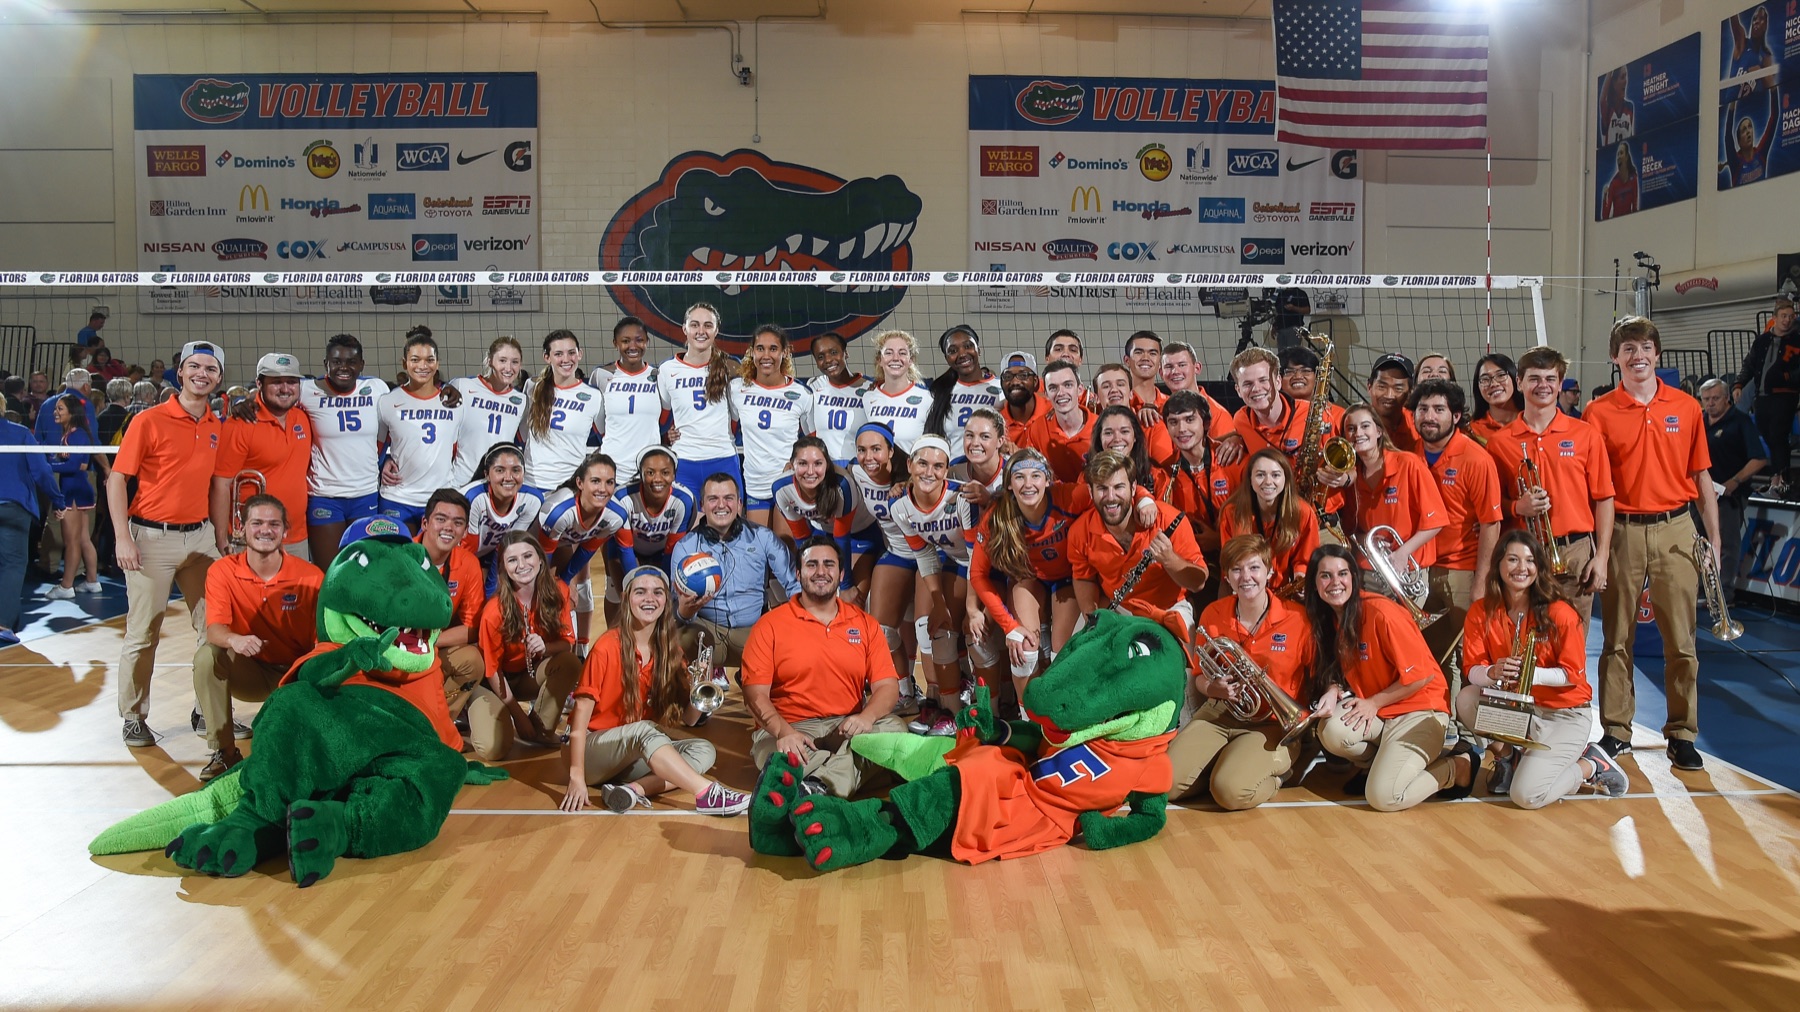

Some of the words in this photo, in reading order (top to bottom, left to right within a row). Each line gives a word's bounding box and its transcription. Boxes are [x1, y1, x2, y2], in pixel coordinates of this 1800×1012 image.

[1643, 72, 1667, 87] HEATHER
[1643, 79, 1669, 96] WRIGHT
[259, 82, 489, 118] VOLLEYBALL
[1092, 86, 1276, 123] VOLLEYBA
[153, 150, 200, 161] WELLS
[403, 149, 443, 164] WCA
[986, 151, 1033, 161] WELLS
[155, 161, 200, 172] FARGO
[234, 156, 295, 168] Domino's
[987, 161, 1033, 172] FARGO
[1067, 158, 1128, 170] Domino's
[1234, 155, 1273, 170] WCA
[1642, 160, 1663, 174] RECEK
[348, 170, 386, 178] Nationwide
[1179, 174, 1217, 182] Nationwide
[280, 197, 340, 210] Honda
[482, 195, 531, 208] ESPN
[998, 199, 1023, 207] Hilton
[1112, 200, 1171, 212] Honda
[165, 206, 205, 216] Garden
[207, 207, 227, 216] Inn
[372, 203, 410, 216] AQUAFINA
[439, 209, 472, 217] TOYOTA
[997, 206, 1037, 216] Garden
[1039, 207, 1058, 216] Inn
[1203, 207, 1240, 219] AQUAFINA
[1309, 202, 1356, 215] ESPN
[1067, 216, 1078, 224] i'm
[144, 242, 206, 253] NISSAN
[214, 240, 264, 253] QUALITY
[350, 241, 389, 251] CAMPUS
[391, 241, 406, 251] USA
[430, 242, 456, 253] pepsi
[463, 236, 524, 251] verizon
[974, 241, 1036, 252] NISSAN
[1045, 240, 1094, 253] QUALITY
[1180, 243, 1219, 254] CAMPUS
[1219, 245, 1236, 254] USA
[1290, 242, 1348, 257] verizon
[225, 252, 260, 260] PLUMBING
[276, 240, 328, 261] COX
[1056, 252, 1090, 260] PLUMBING
[1107, 241, 1159, 263] COX
[1259, 246, 1283, 257] pepsi
[59, 273, 99, 283] FLORIDA
[101, 273, 139, 284] GATORS
[170, 273, 211, 283] FLORIDA
[213, 273, 251, 283] GATORS
[282, 273, 323, 283] FLORIDA
[325, 273, 363, 283] GATORS
[394, 272, 436, 283] FLORIDA
[437, 273, 476, 283] GATORS
[507, 272, 549, 283] FLORIDA
[550, 272, 589, 283] GATORS
[621, 272, 662, 283] FLORIDA
[664, 272, 703, 283] GATORS
[735, 272, 777, 283] FLORIDA
[778, 272, 817, 283] GATORS
[849, 272, 890, 283] FLORIDA
[892, 272, 930, 283] GATORS
[962, 272, 1003, 283] FLORIDA
[1005, 273, 1043, 283] GATORS
[1074, 273, 1115, 283] FLORIDA
[1116, 273, 1155, 283] GATORS
[1185, 274, 1225, 284] FLORIDA
[1227, 274, 1264, 284] GATORS
[1294, 274, 1334, 285] FLORIDA
[1336, 274, 1372, 285] GATORS
[1400, 276, 1440, 286] FLORIDA
[1441, 276, 1477, 286] GATORS
[149, 291, 172, 299] Tower
[174, 290, 189, 298] Hill
[1003, 289, 1018, 297] Hill
[608, 382, 657, 394] FLORIDA
[319, 396, 373, 408] FLORIDA
[553, 397, 586, 412] RIDA
[628, 394, 635, 414] 1
[692, 389, 707, 411] 5
[743, 395, 793, 411] FLORIDA
[817, 394, 864, 409] FLORIDA
[471, 397, 518, 416] FLORIDA
[869, 405, 918, 419] FLORIDA
[336, 409, 362, 432] 15
[400, 409, 454, 421] FLORIDA
[550, 409, 567, 431] 2
[757, 409, 772, 430] 9
[827, 409, 848, 431] 10
[957, 406, 973, 427] 2
[487, 413, 502, 435] 11
[421, 422, 436, 444] 3
[873, 504, 894, 520] 2
[911, 516, 961, 533] FLORIDA
[927, 533, 955, 547] 14
[1041, 547, 1059, 561] 6
